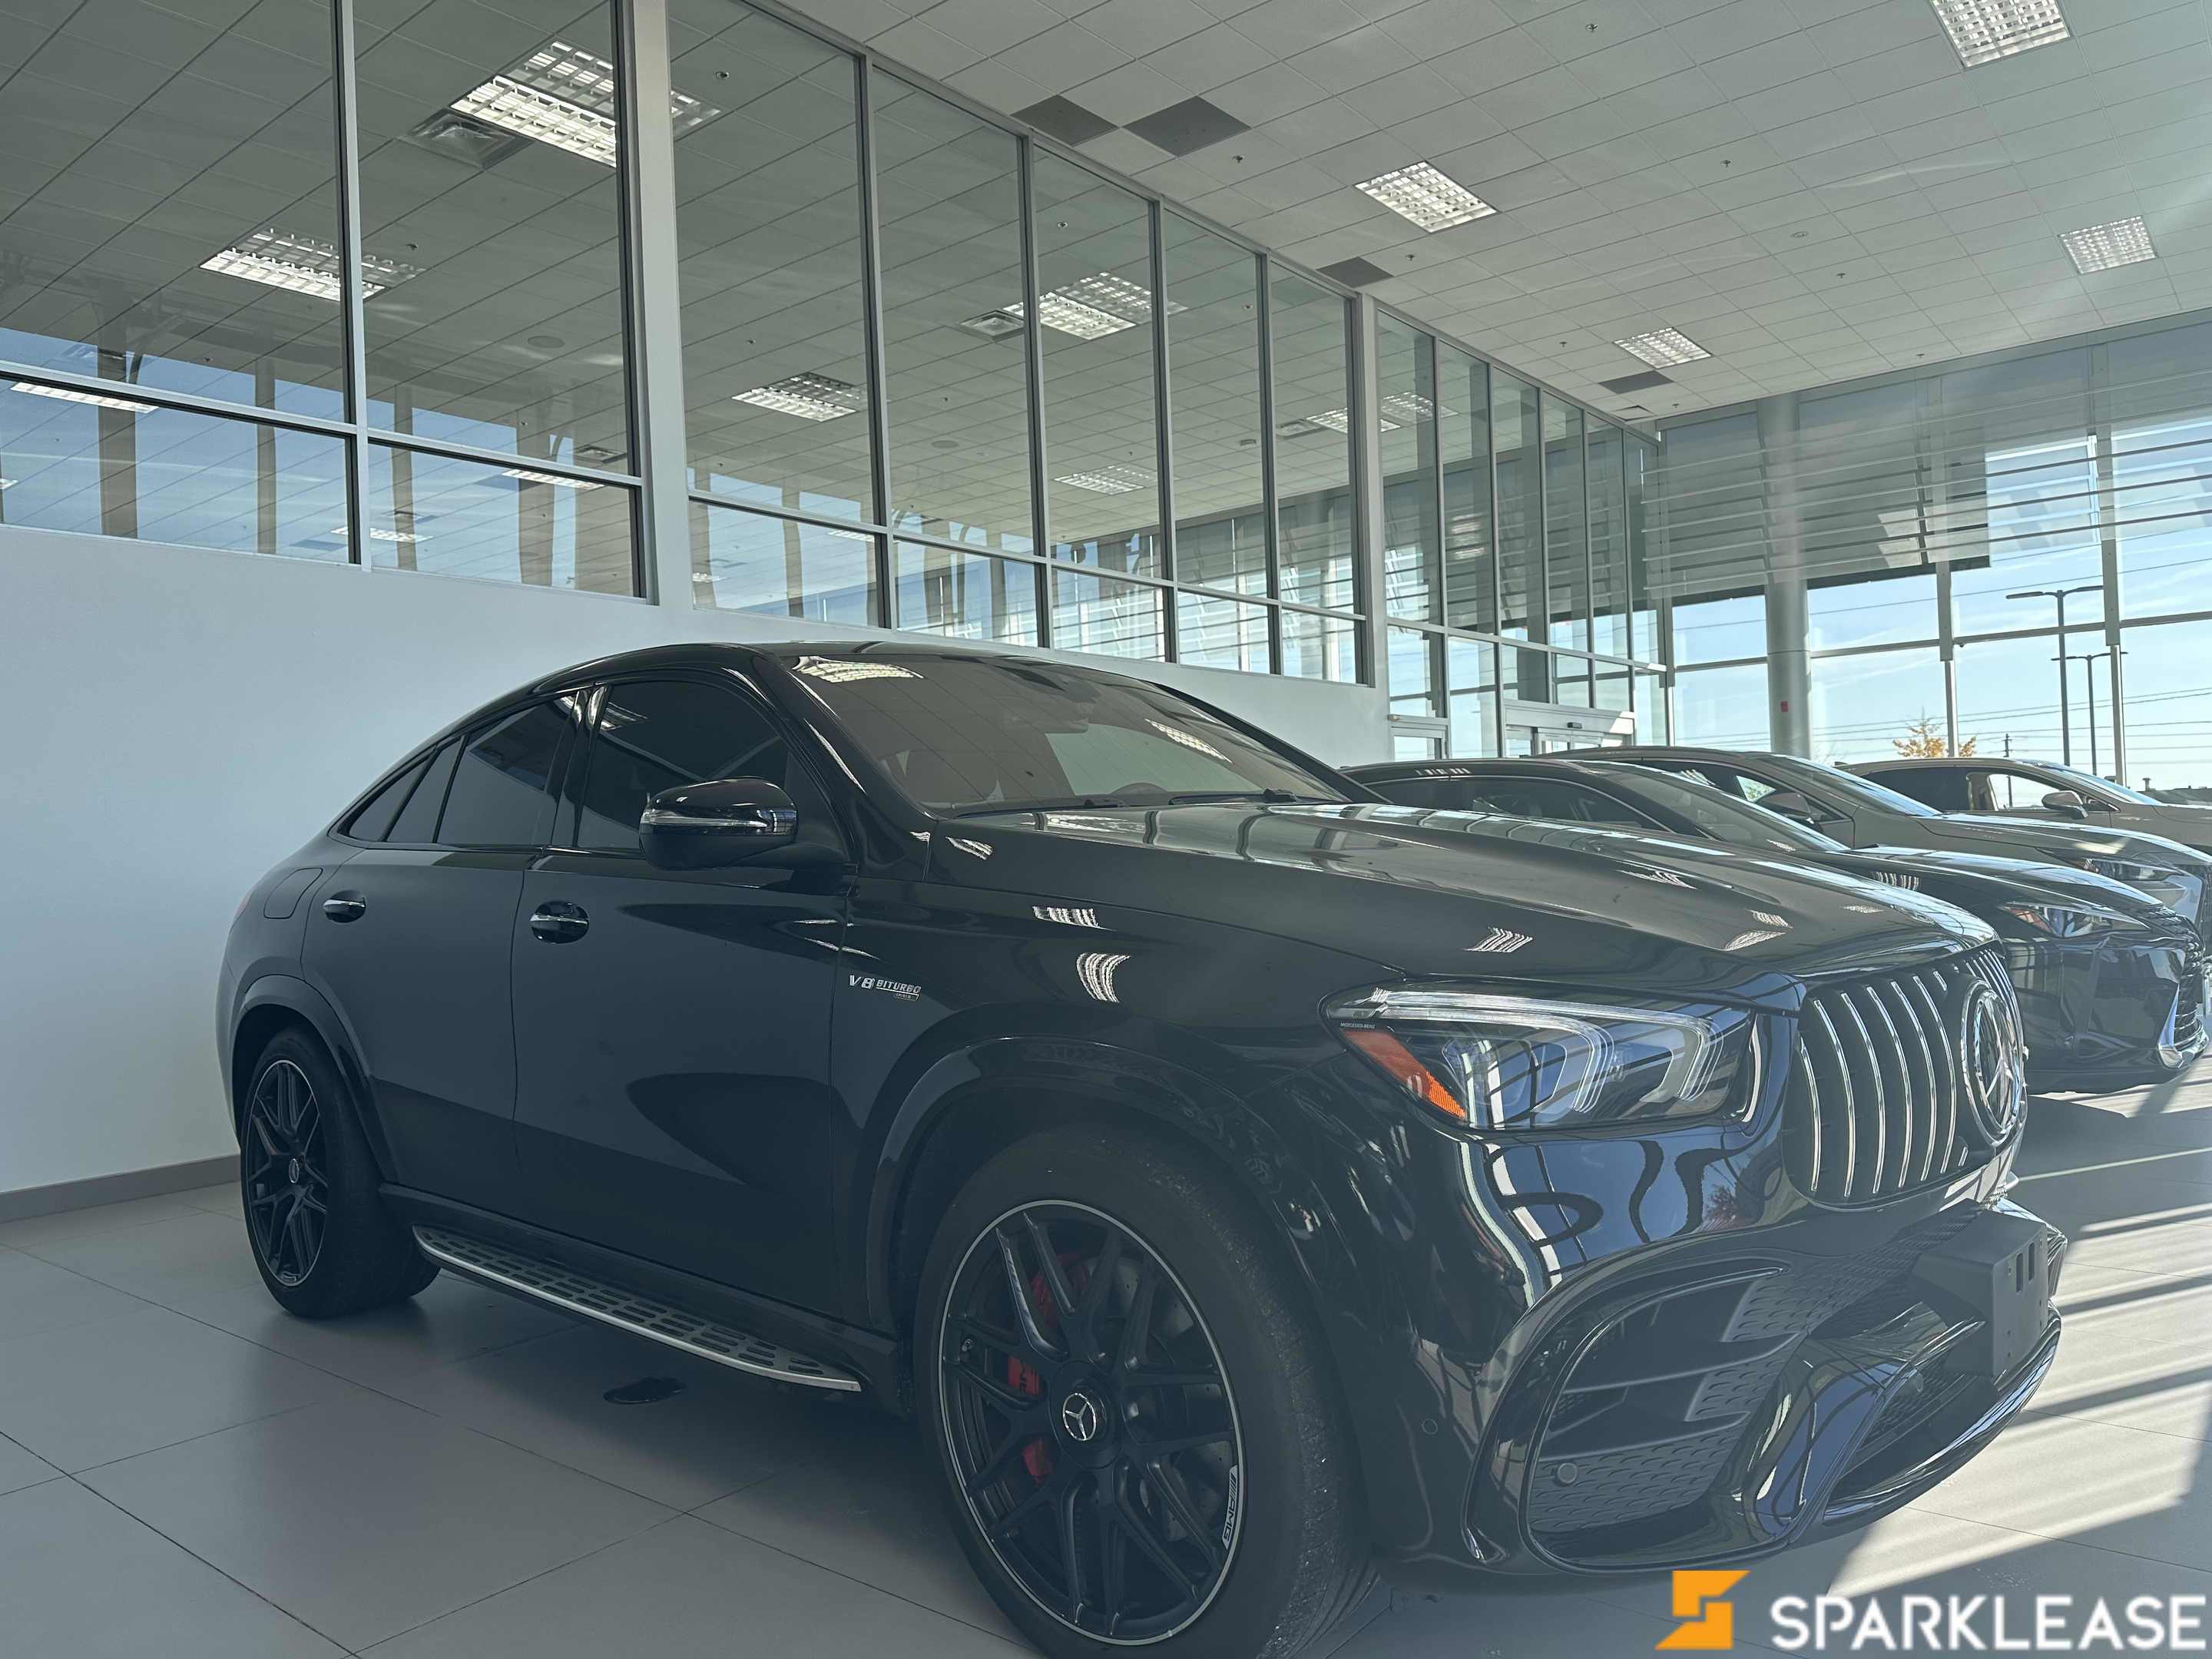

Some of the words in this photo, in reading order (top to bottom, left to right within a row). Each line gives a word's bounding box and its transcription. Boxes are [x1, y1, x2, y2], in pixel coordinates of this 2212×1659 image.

[849, 975, 875, 989] V8
[876, 979, 922, 994] BITURBO
[1224, 1498, 1237, 1542] AMG
